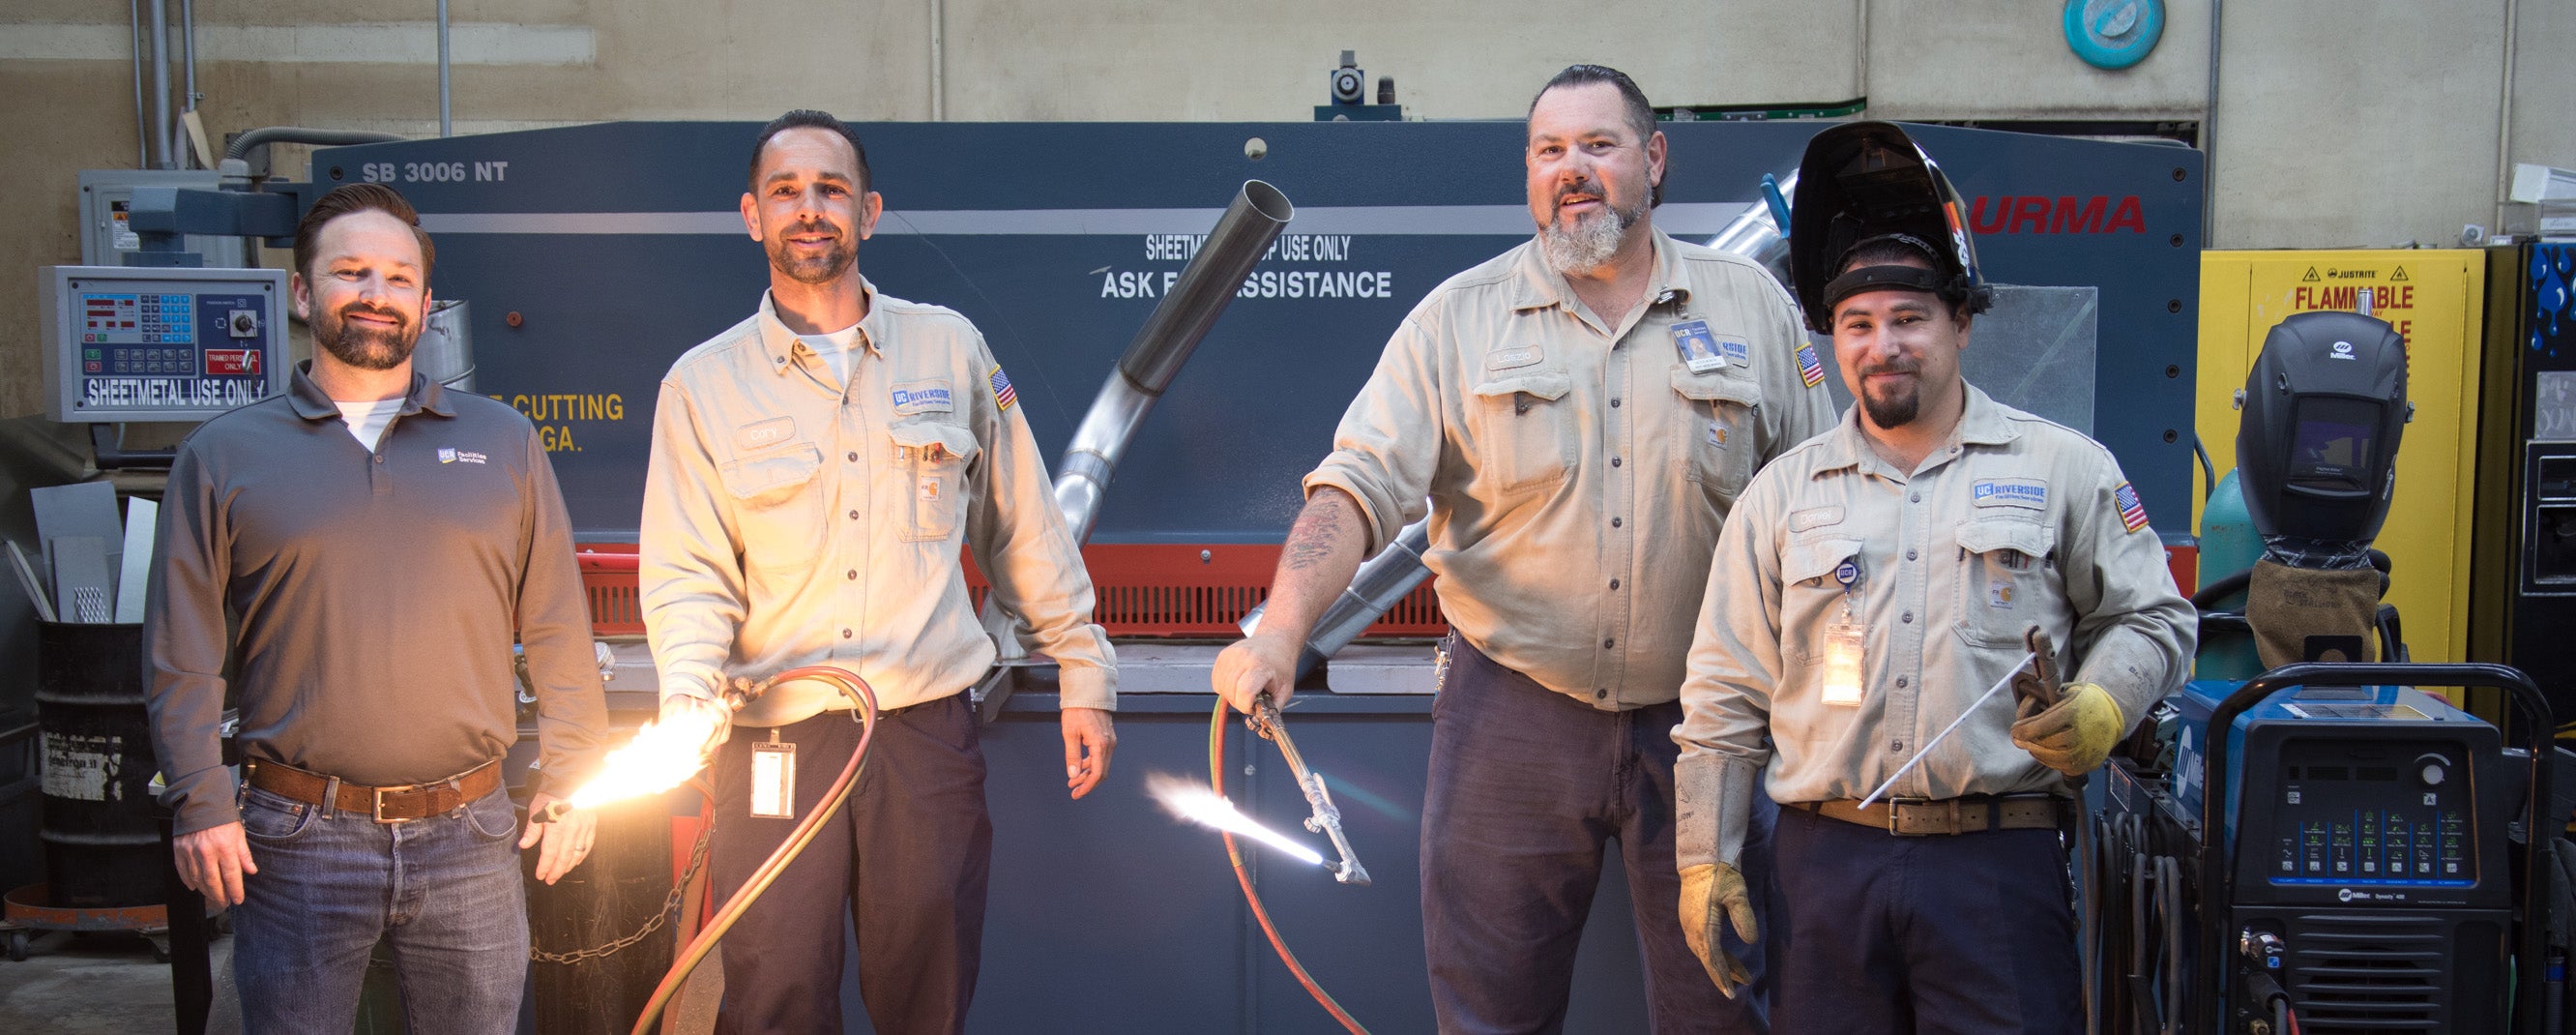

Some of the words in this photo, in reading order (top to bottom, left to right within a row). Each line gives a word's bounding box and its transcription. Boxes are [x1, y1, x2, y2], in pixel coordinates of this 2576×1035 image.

[363, 163, 396, 182] SB
[404, 162, 466, 182] 3006
[475, 162, 509, 182] NT
[1969, 195, 2147, 234] URMA
[1146, 235, 1208, 260] SHEETM
[1281, 236, 1309, 260] USE
[1313, 235, 1351, 261] ONLY
[1101, 271, 1155, 298] ASK
[1237, 271, 1391, 298] SSISTANCE
[1674, 328, 1692, 338] UCR
[88, 378, 187, 406] SHEETMETAL
[190, 379, 220, 406] USE
[225, 379, 265, 406] ONLY
[893, 391, 908, 403] UC
[909, 388, 951, 402] RIVERSIDE
[512, 393, 624, 421] CUTTING
[439, 450, 454, 458] UCR
[1977, 486, 1992, 496] UC
[1995, 484, 2046, 497] RIVERSIDE
